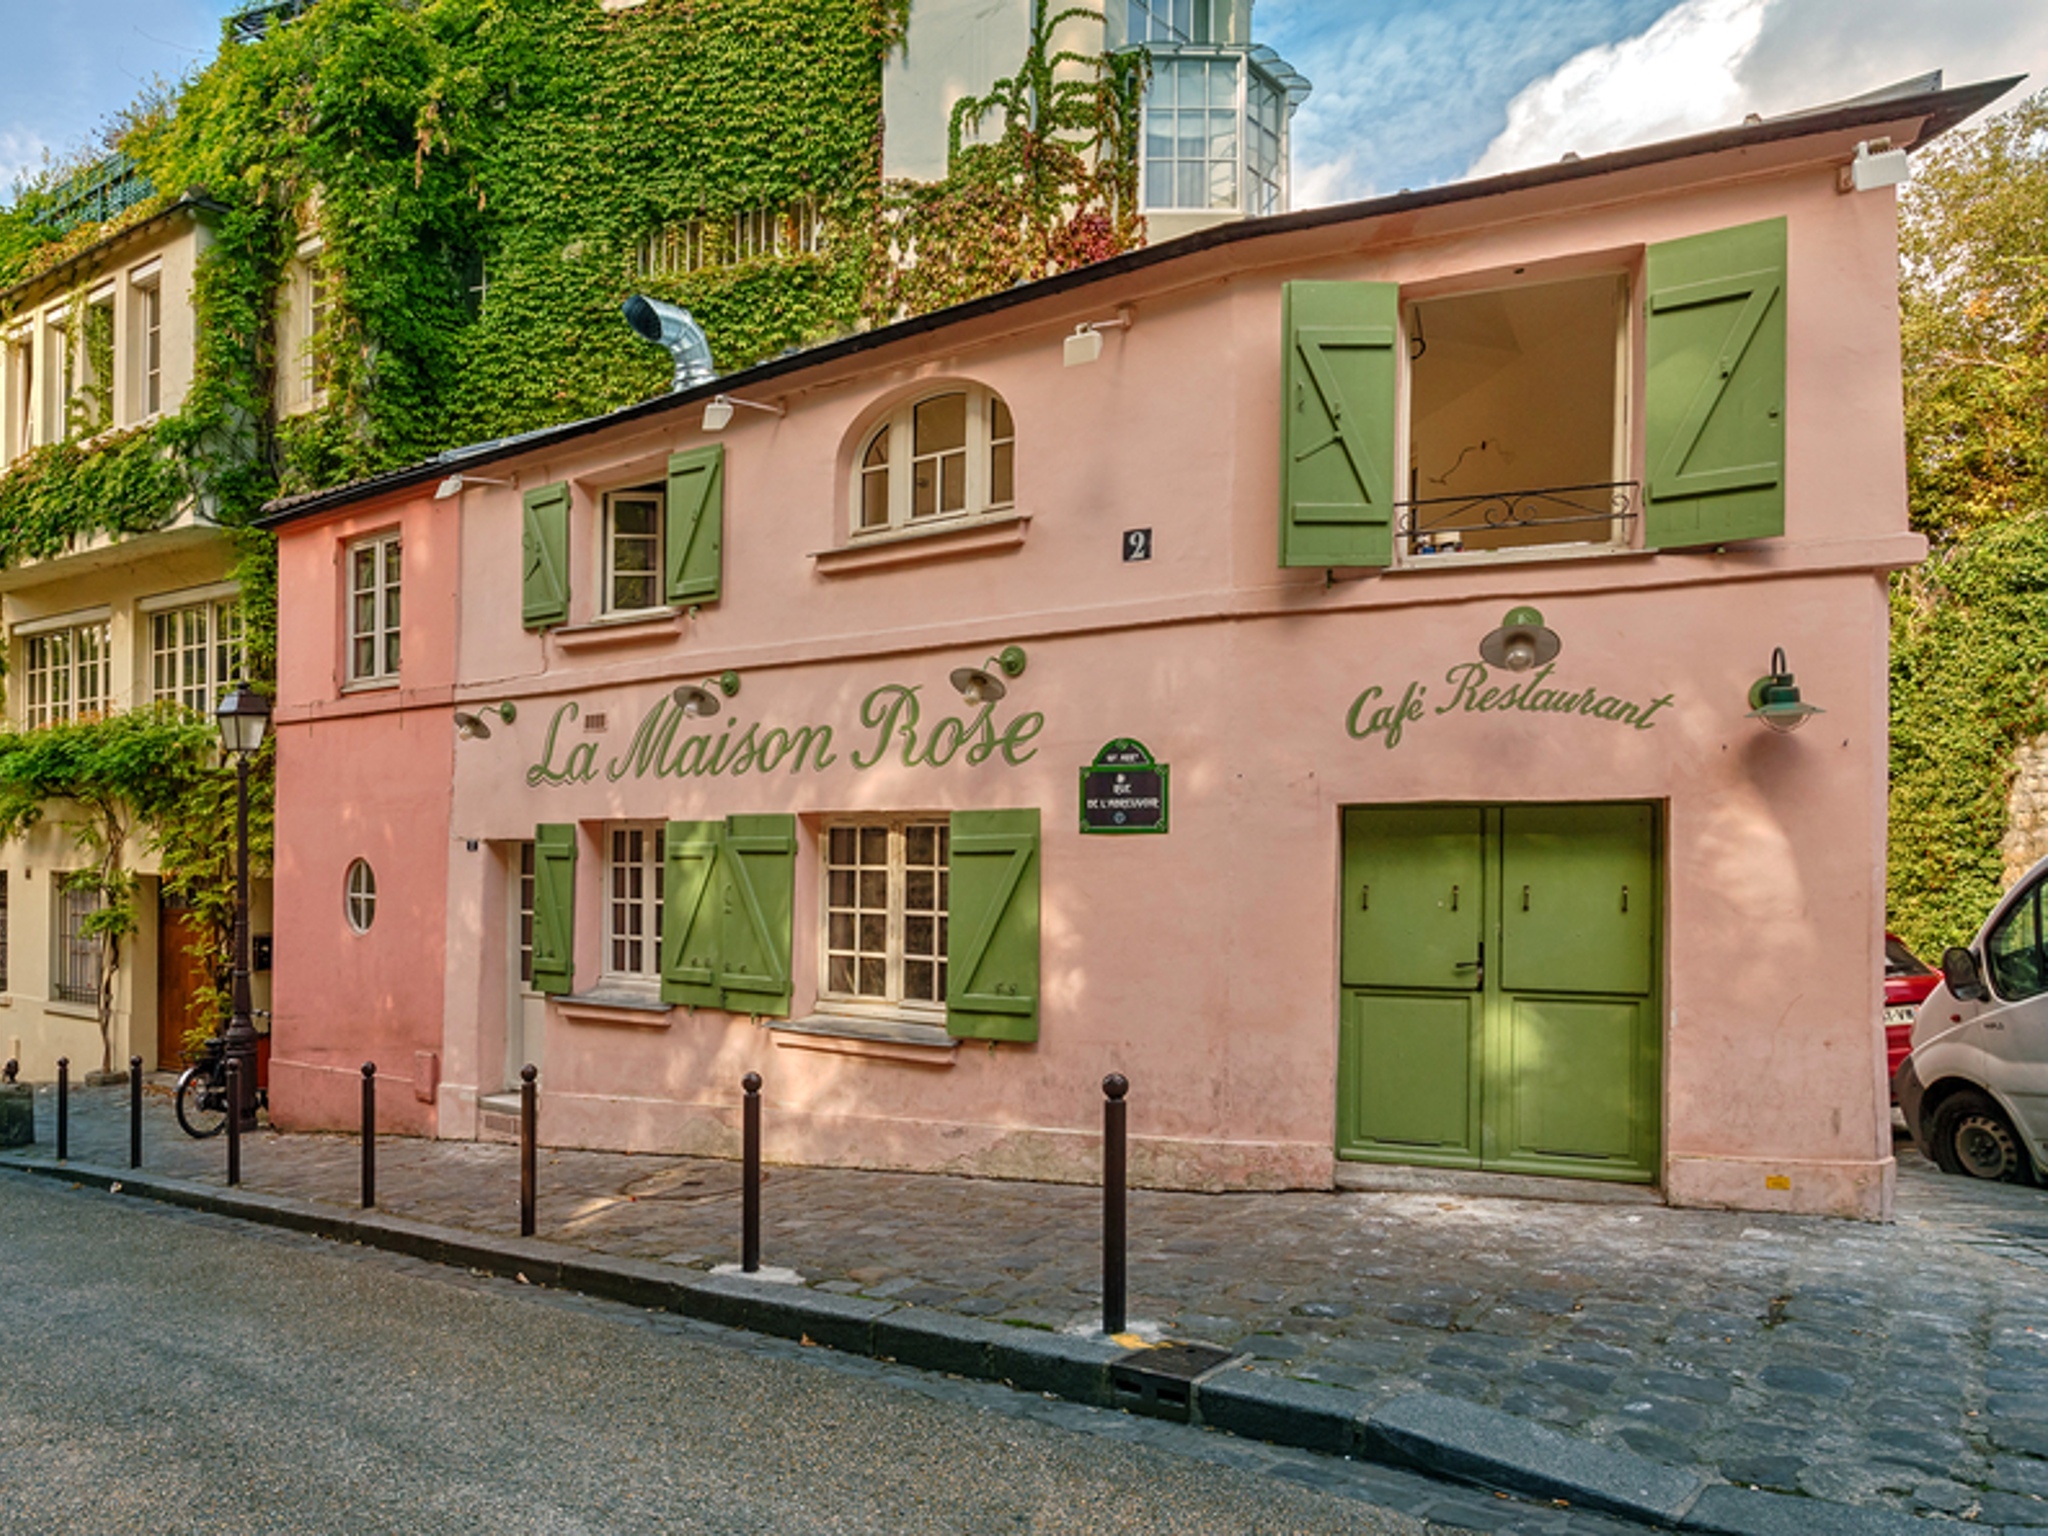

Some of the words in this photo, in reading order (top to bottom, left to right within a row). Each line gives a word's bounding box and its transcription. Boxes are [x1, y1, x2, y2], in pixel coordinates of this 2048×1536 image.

[1129, 531, 1145, 560] 2
[527, 702, 599, 787] La
[606, 694, 837, 781] Maison
[851, 683, 1045, 767] Rose
[1346, 681, 1427, 749] Café
[1435, 661, 1675, 729] Restaurant
